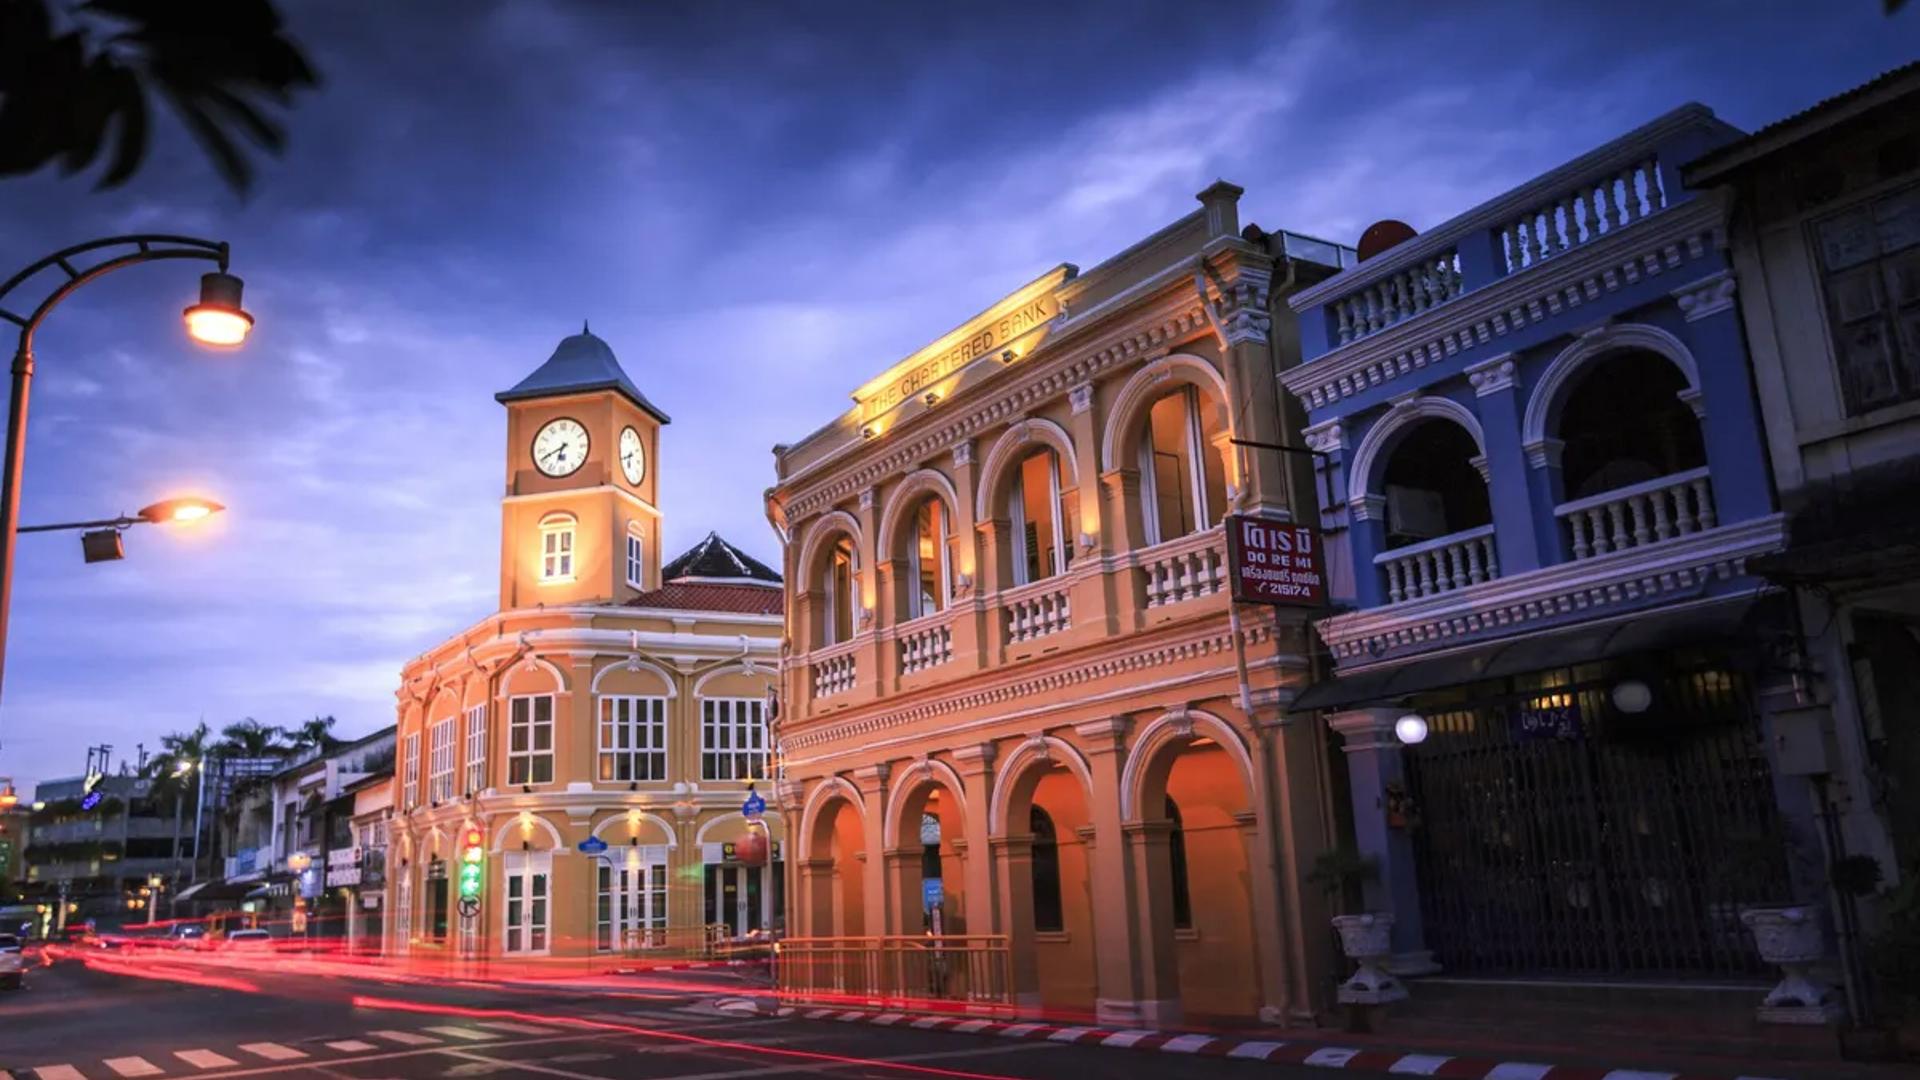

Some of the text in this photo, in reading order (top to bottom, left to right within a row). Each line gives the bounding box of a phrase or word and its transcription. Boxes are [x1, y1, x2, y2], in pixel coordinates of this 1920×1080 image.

[870, 299, 1047, 409] THE CHARTERED BANK
[1247, 551, 1311, 569] DO RE MI
[1270, 582, 1311, 597] 215174
